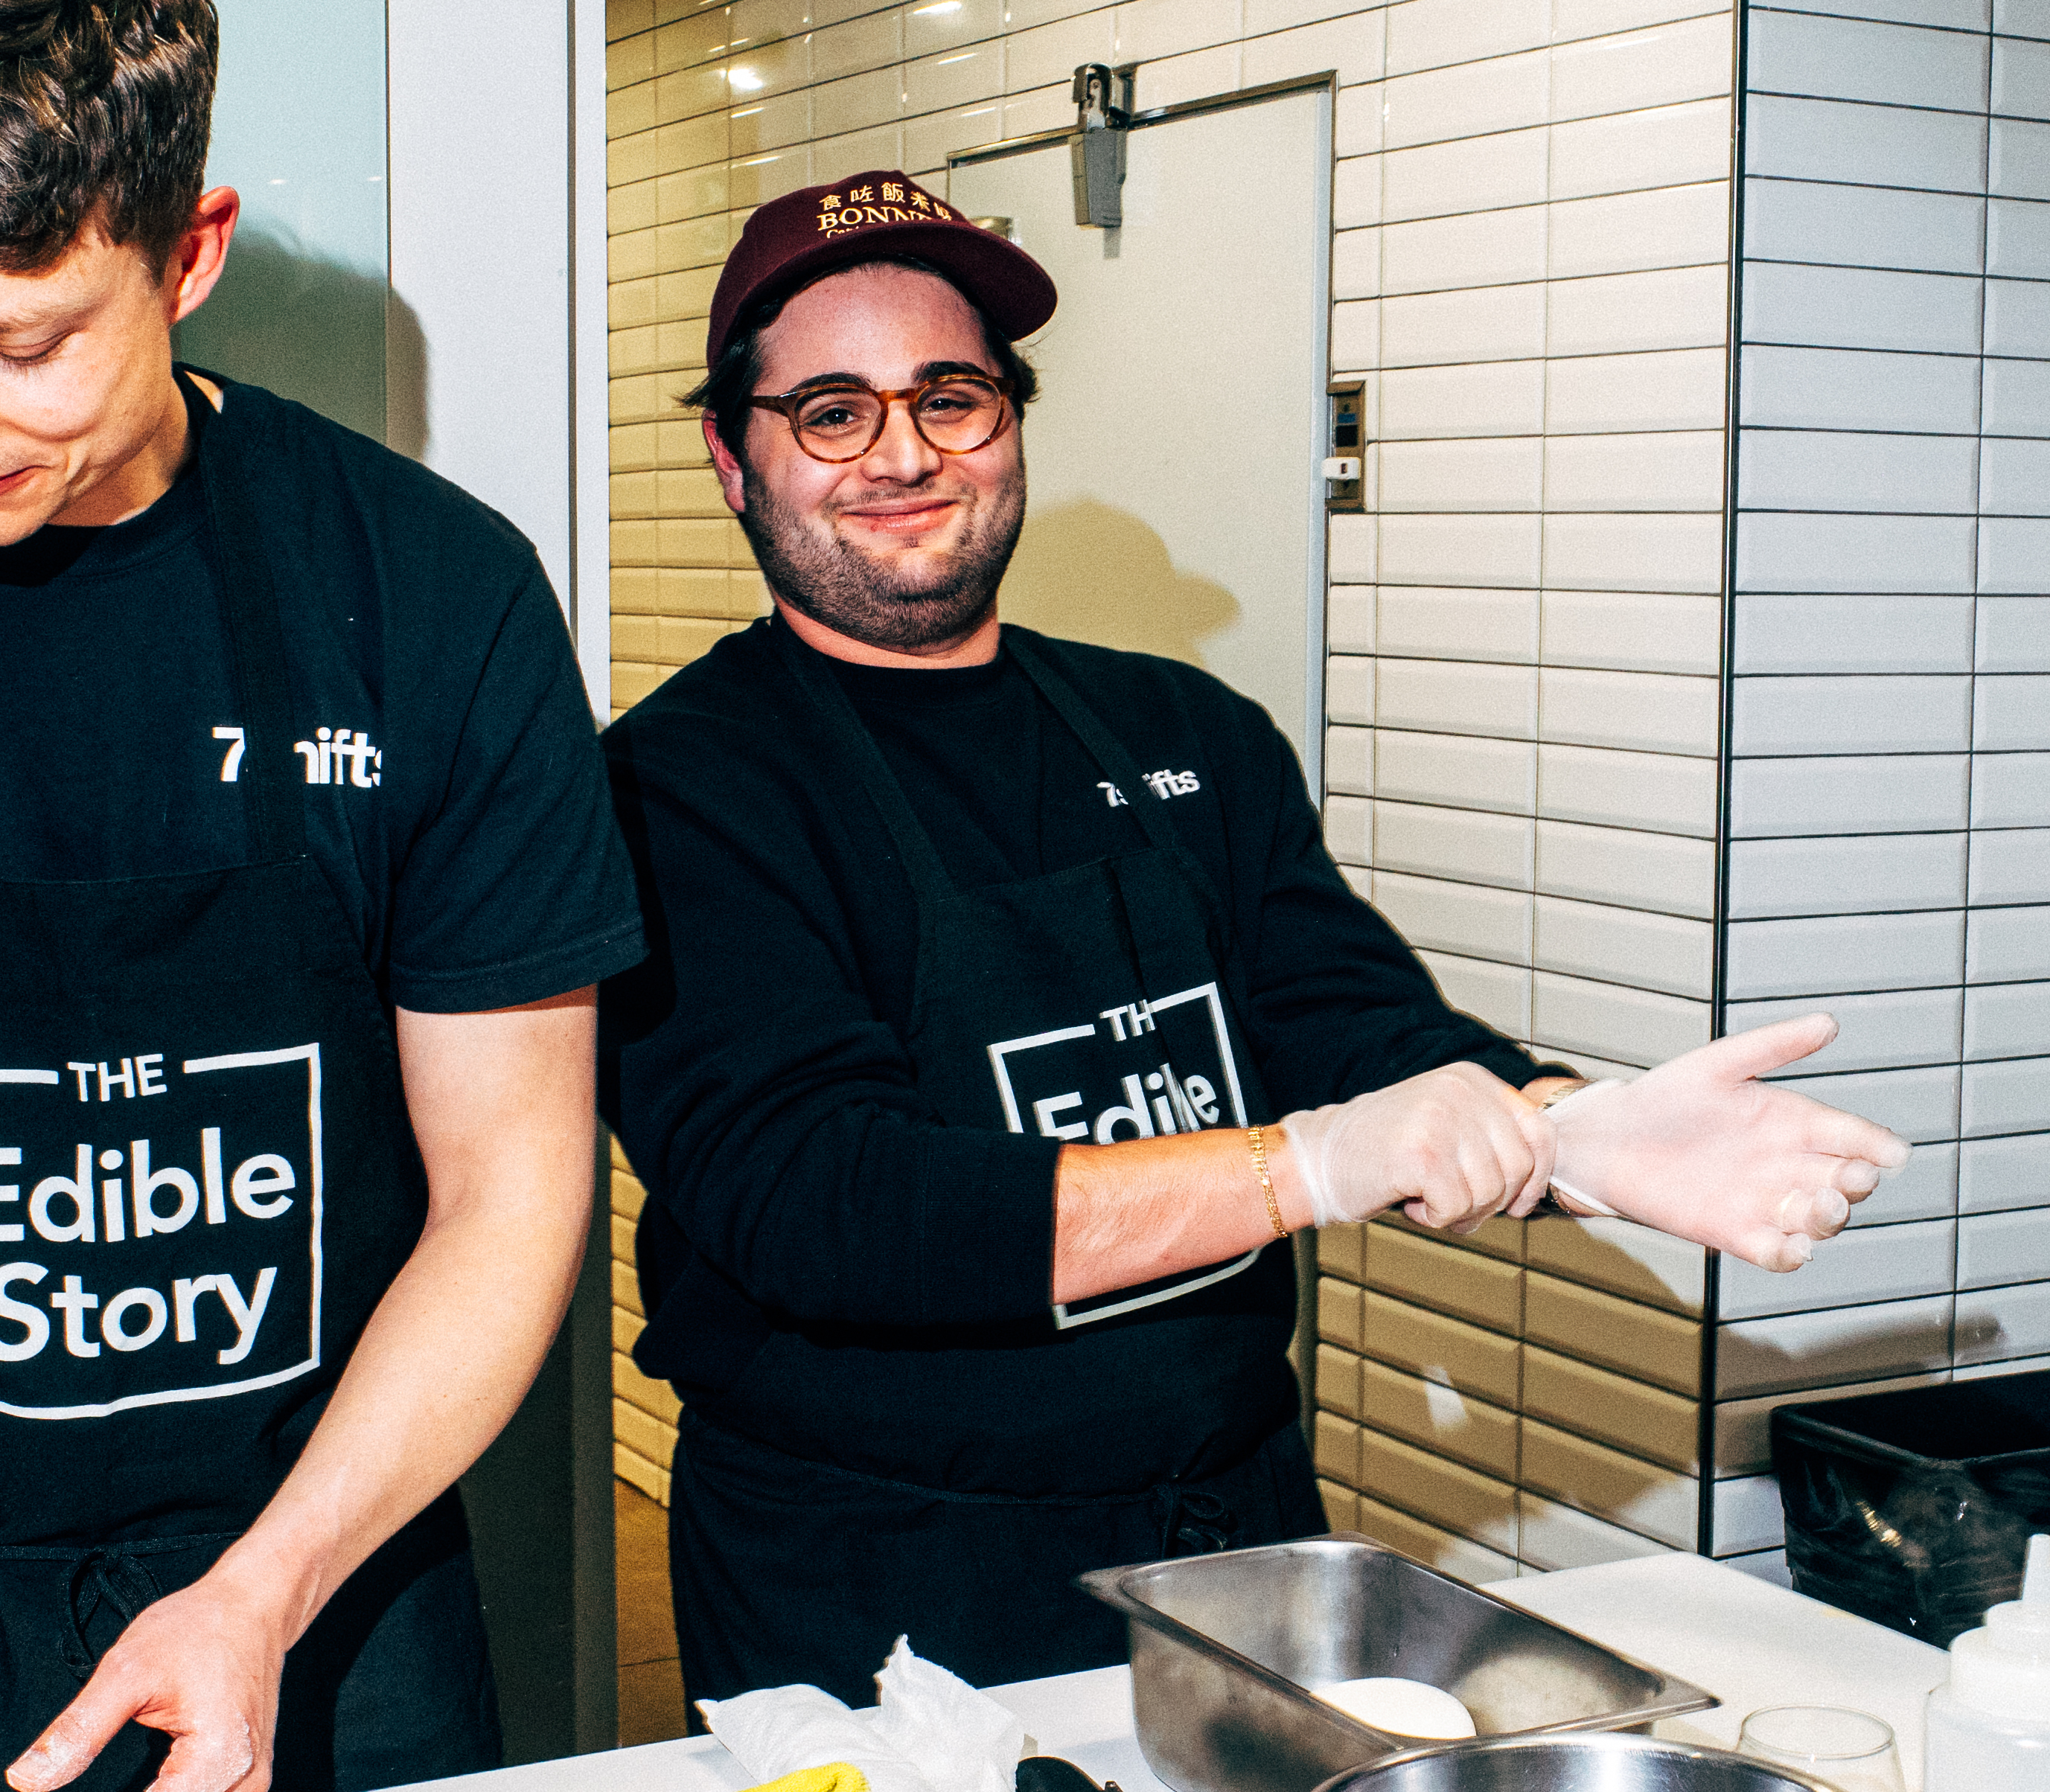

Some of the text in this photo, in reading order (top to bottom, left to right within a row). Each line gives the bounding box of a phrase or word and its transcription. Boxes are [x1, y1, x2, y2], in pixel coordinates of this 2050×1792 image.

[1099, 999, 1156, 1042] TH
[67, 1053, 167, 1102] THE
[0, 1261, 278, 1365] Story
